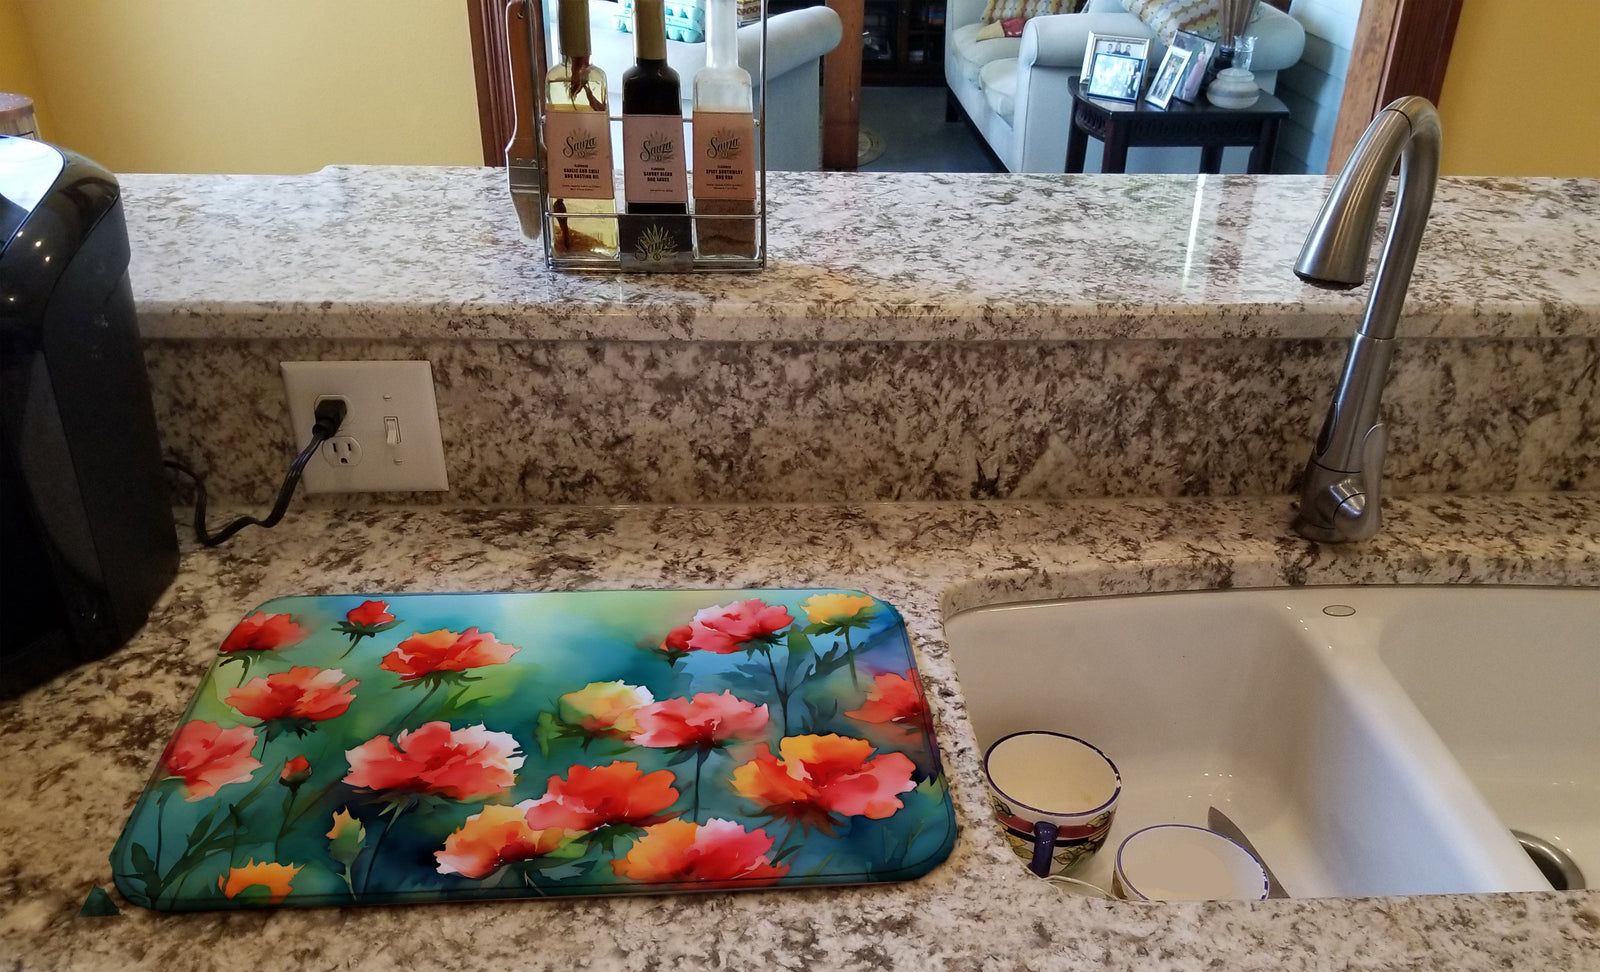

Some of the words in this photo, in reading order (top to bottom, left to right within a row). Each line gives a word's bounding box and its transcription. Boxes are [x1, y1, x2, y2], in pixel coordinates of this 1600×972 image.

[563, 136, 598, 158] Sauza
[640, 140, 673, 162] Sauza
[706, 136, 741, 158] Sauza
